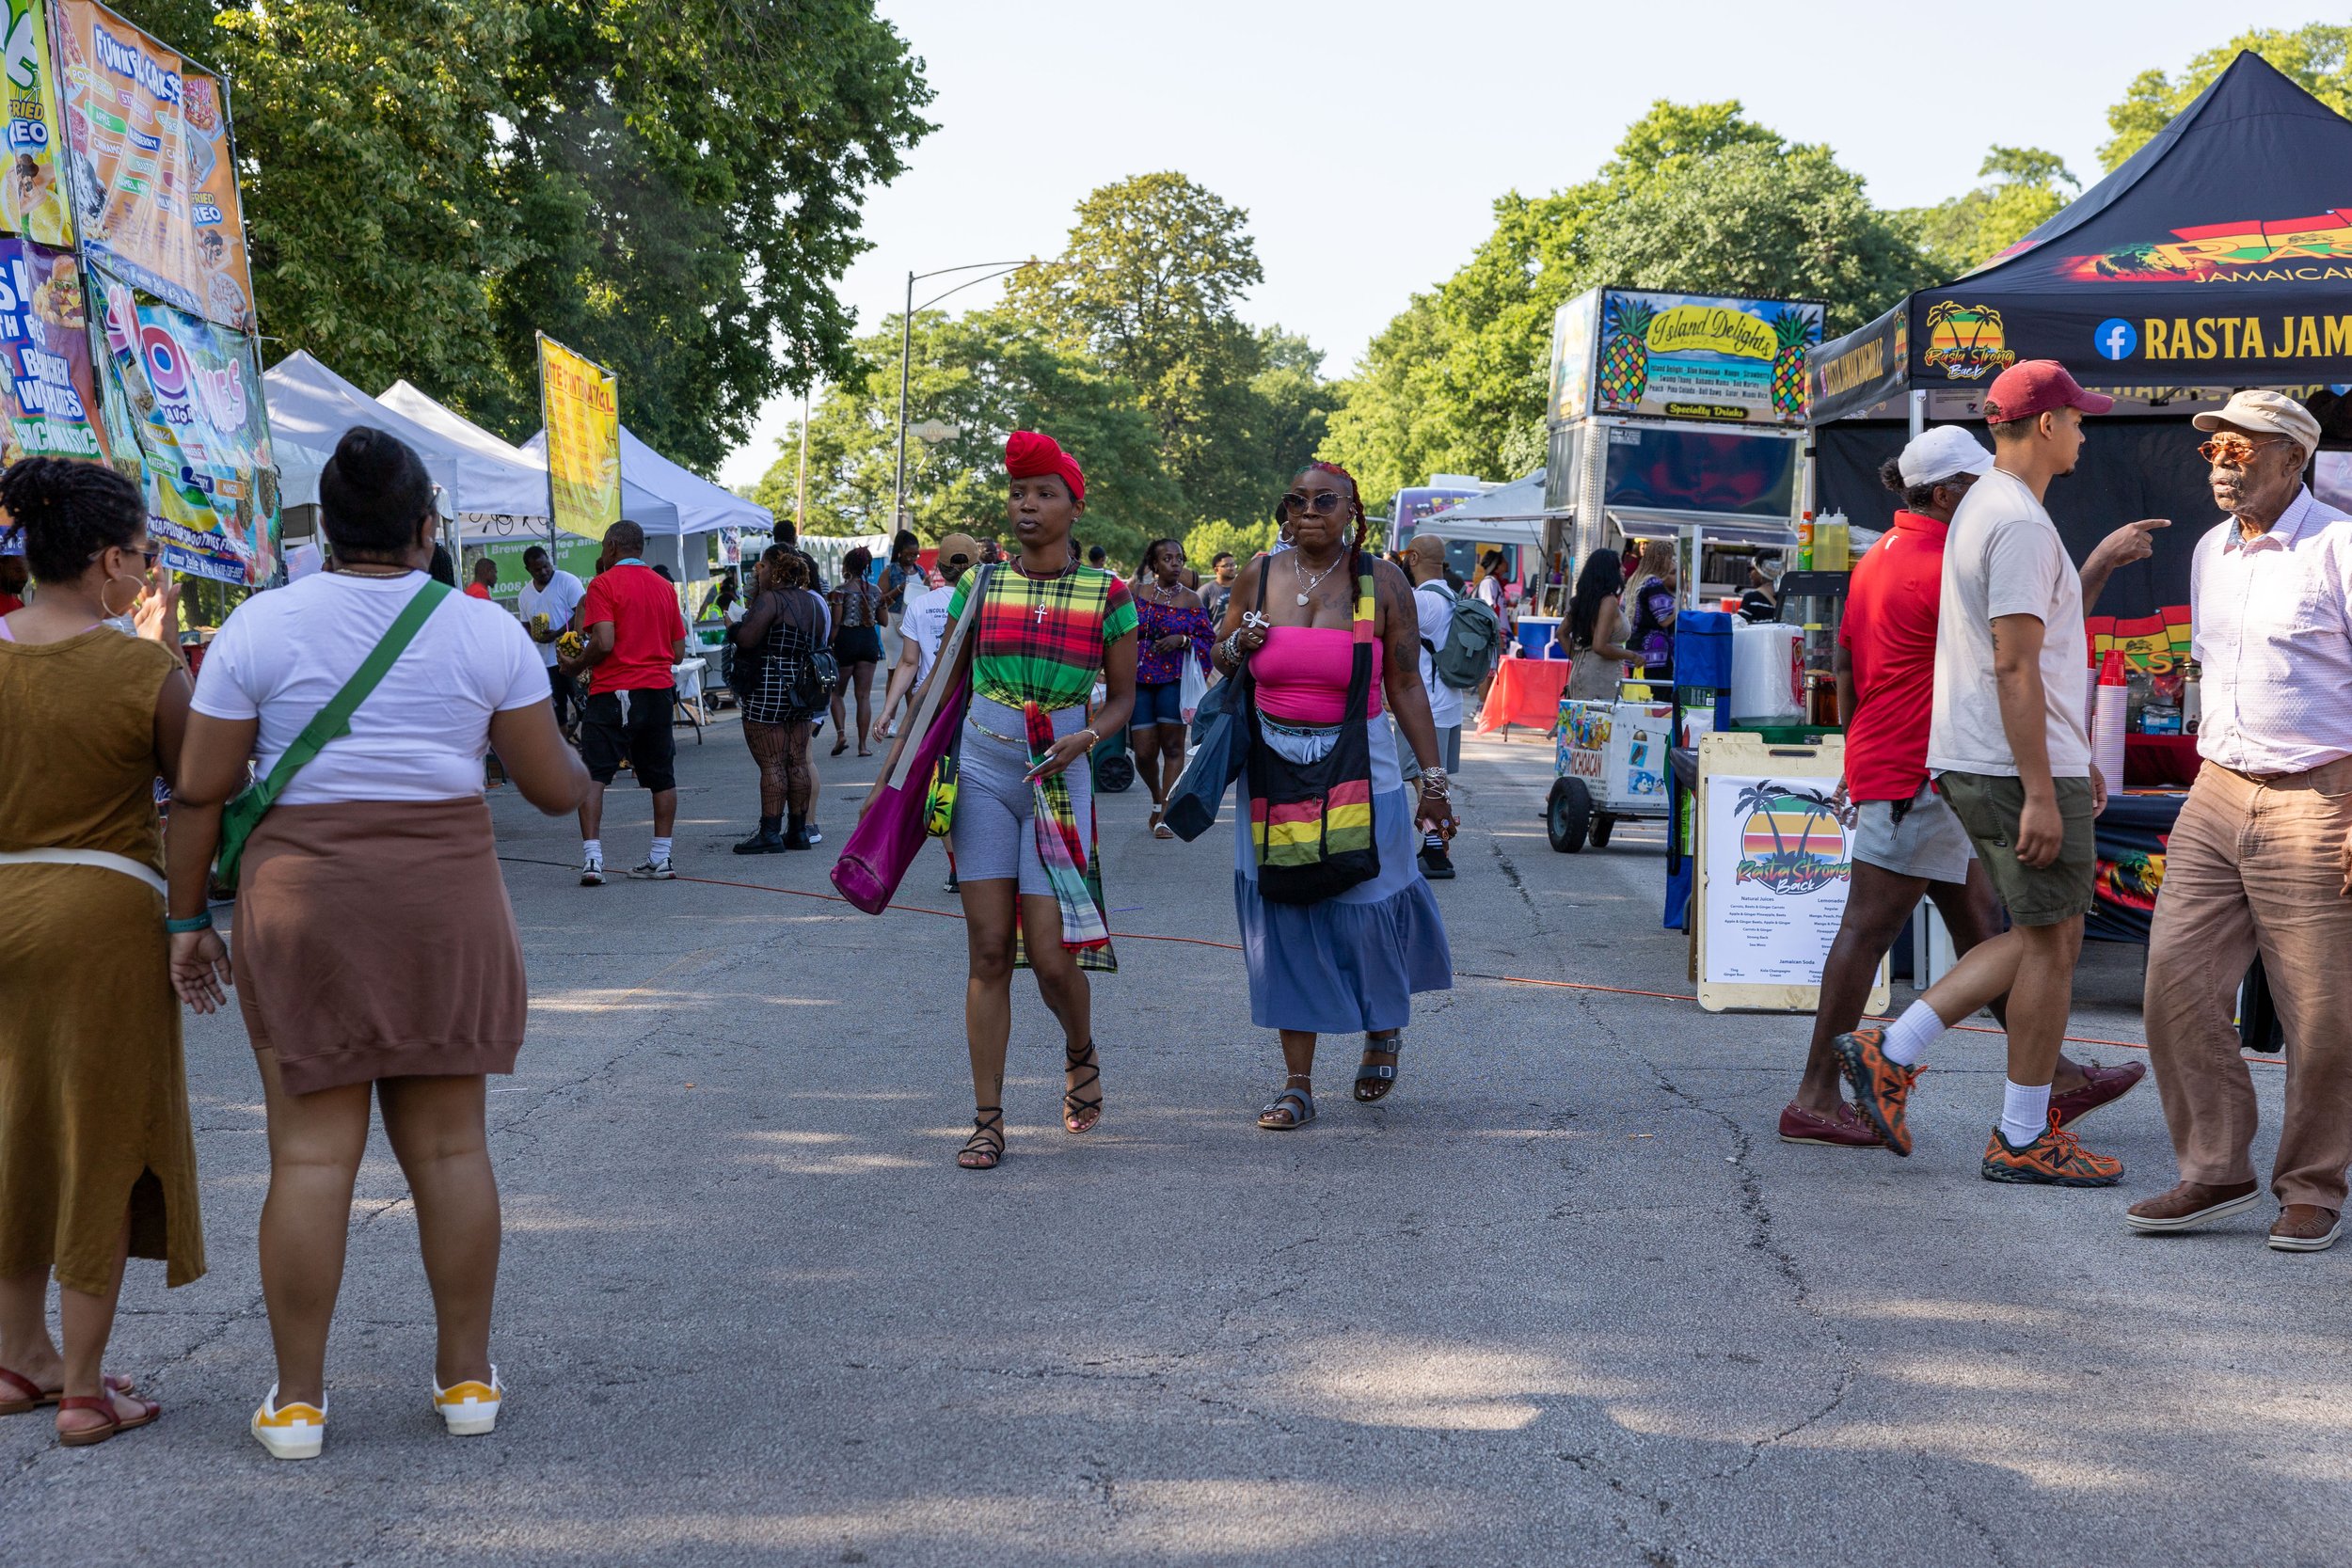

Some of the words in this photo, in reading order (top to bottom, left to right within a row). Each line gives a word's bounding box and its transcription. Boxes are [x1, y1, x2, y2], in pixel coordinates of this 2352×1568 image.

[192, 206, 223, 226] REO
[1651, 309, 1710, 346] Island
[1710, 309, 1772, 356] Delights
[2144, 317, 2266, 360] RASTA
[1925, 347, 1965, 367] Rasta
[1969, 343, 2015, 371] Strong
[1948, 363, 1984, 378] Back
[1669, 403, 1711, 418] Specialty
[1713, 405, 1744, 418] Drinks
[492, 581, 522, 594] 1008
[1736, 857, 1790, 886] Rasta
[1792, 857, 1851, 883] Strong
[1775, 878, 1817, 895] Back
